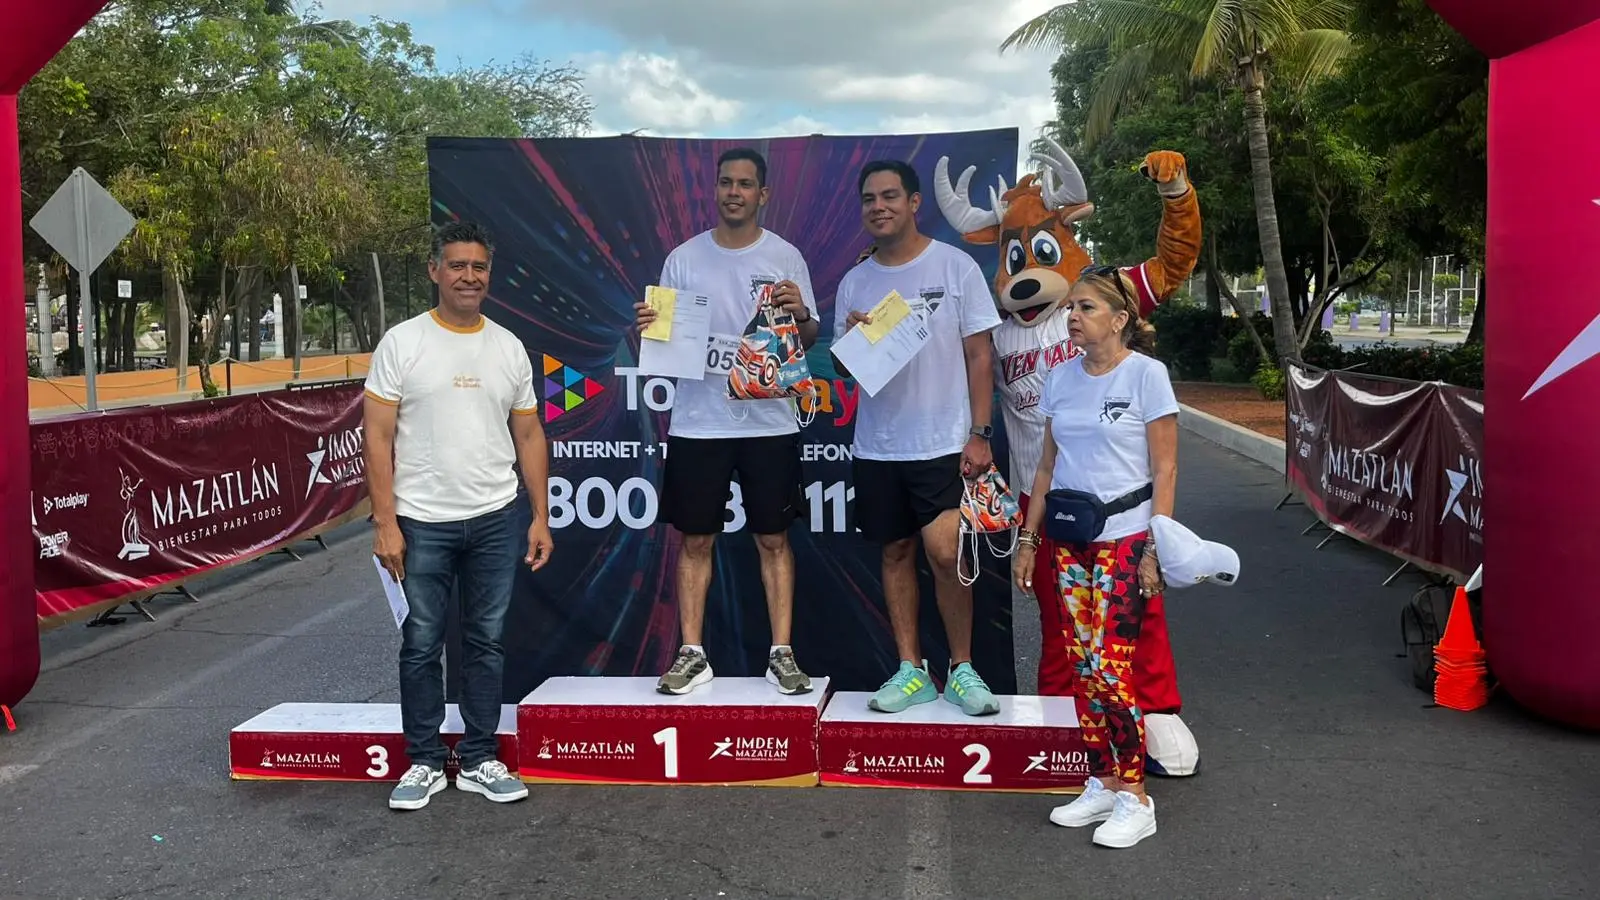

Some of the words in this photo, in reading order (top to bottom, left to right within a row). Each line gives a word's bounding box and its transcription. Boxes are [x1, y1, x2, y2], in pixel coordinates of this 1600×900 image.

[328, 426, 364, 462] IMDE
[553, 440, 641, 459] INTERNET
[1328, 440, 1413, 501] MAZATLÁN
[53, 491, 89, 510] Totalplay
[150, 457, 280, 529] MAZATLÁN
[547, 476, 659, 530] 800
[158, 524, 218, 552] BIENESTAR
[223, 516, 248, 531] PARA
[252, 505, 282, 523] TODOS
[40, 531, 69, 549] POWER
[556, 740, 635, 754] MAZATLÁN
[652, 726, 678, 778] 1
[736, 736, 789, 749] IMDEM
[276, 752, 340, 764] MAZATLÁN
[365, 744, 391, 778] 3
[735, 748, 788, 758] MAZATLÁN
[863, 753, 945, 768] MAZATLÁN
[962, 743, 992, 784] 2
[1050, 763, 1091, 773] MAZATL
